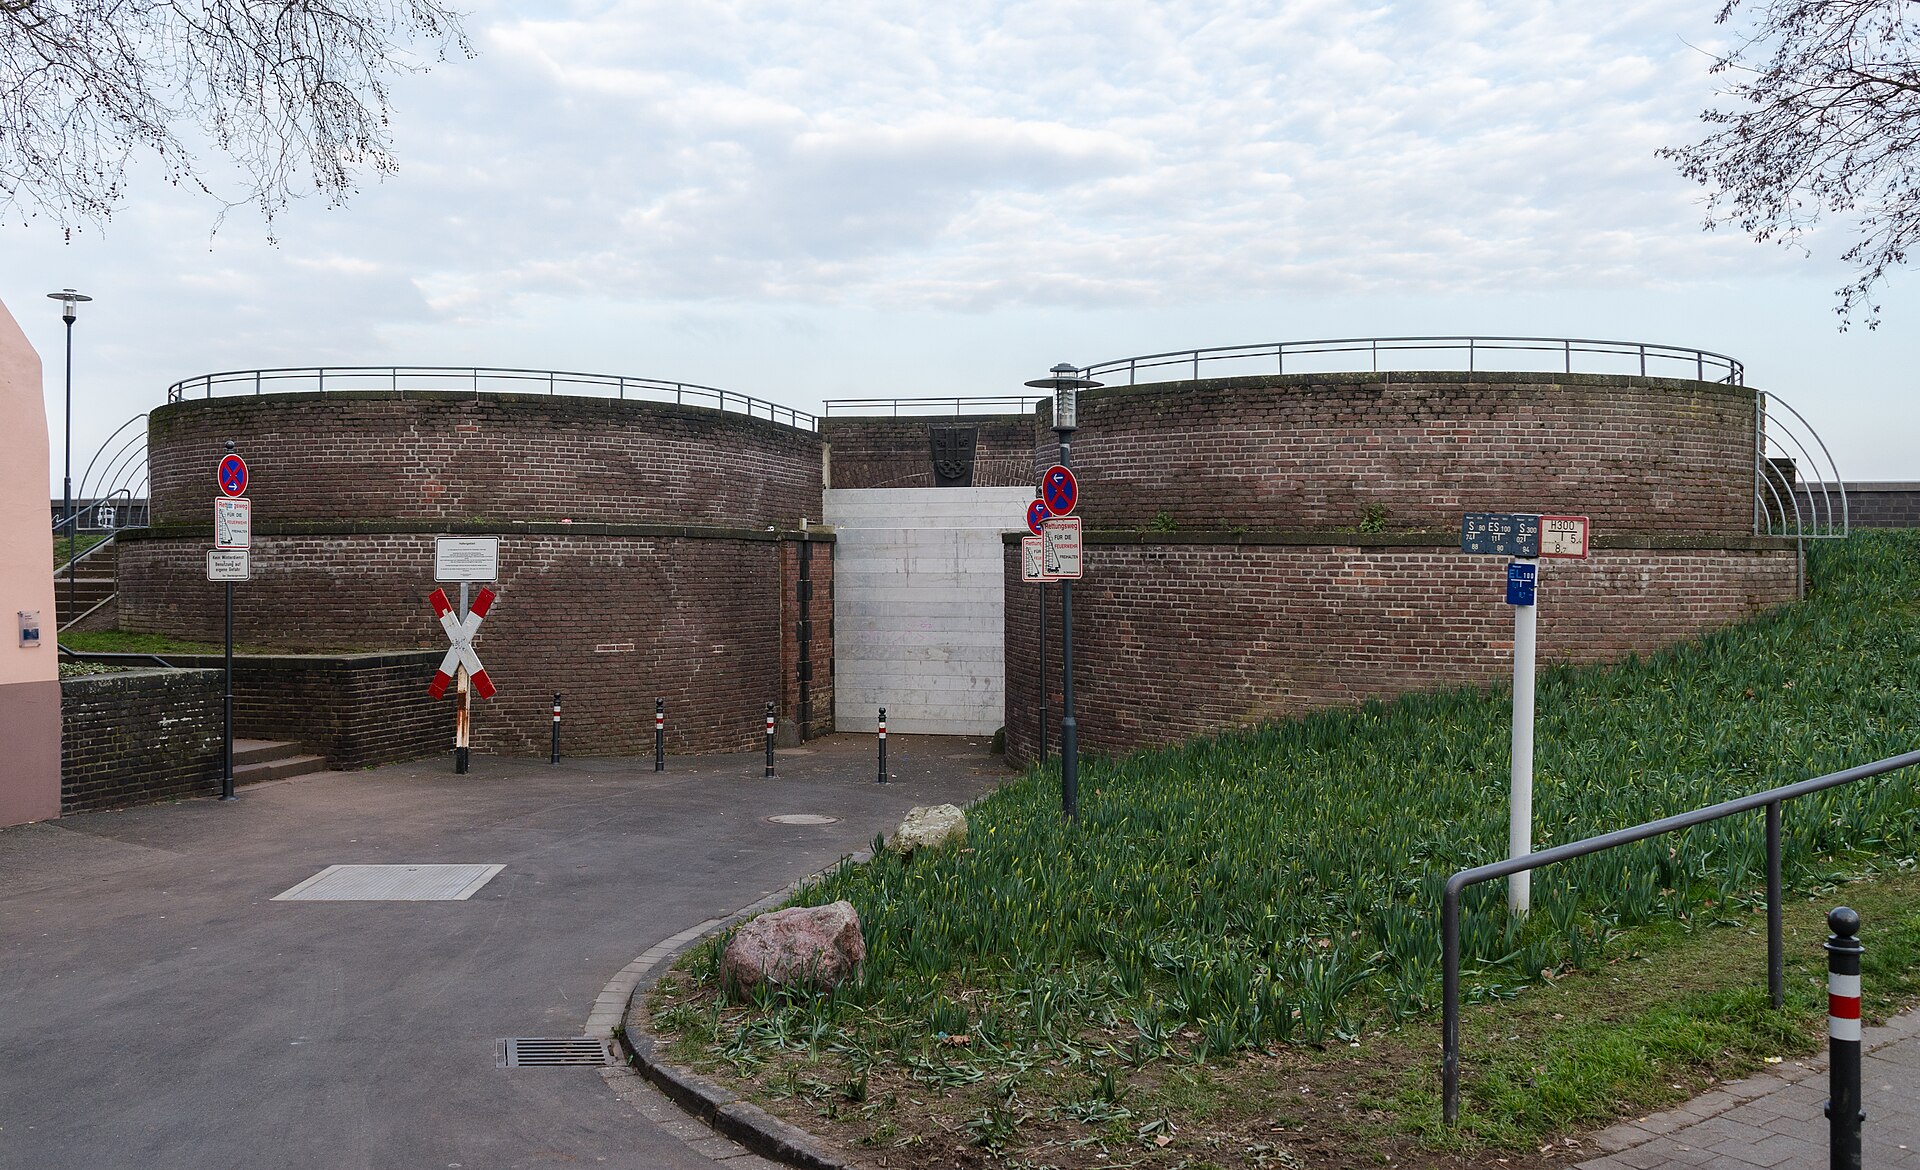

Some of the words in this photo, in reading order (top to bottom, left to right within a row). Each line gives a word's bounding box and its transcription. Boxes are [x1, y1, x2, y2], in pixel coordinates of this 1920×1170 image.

[1468, 521, 1474, 531] S
[1488, 522, 1499, 532] ES
[1519, 523, 1526, 533] S
[1551, 520, 1575, 530] H300
[1509, 569, 1522, 578] EL
